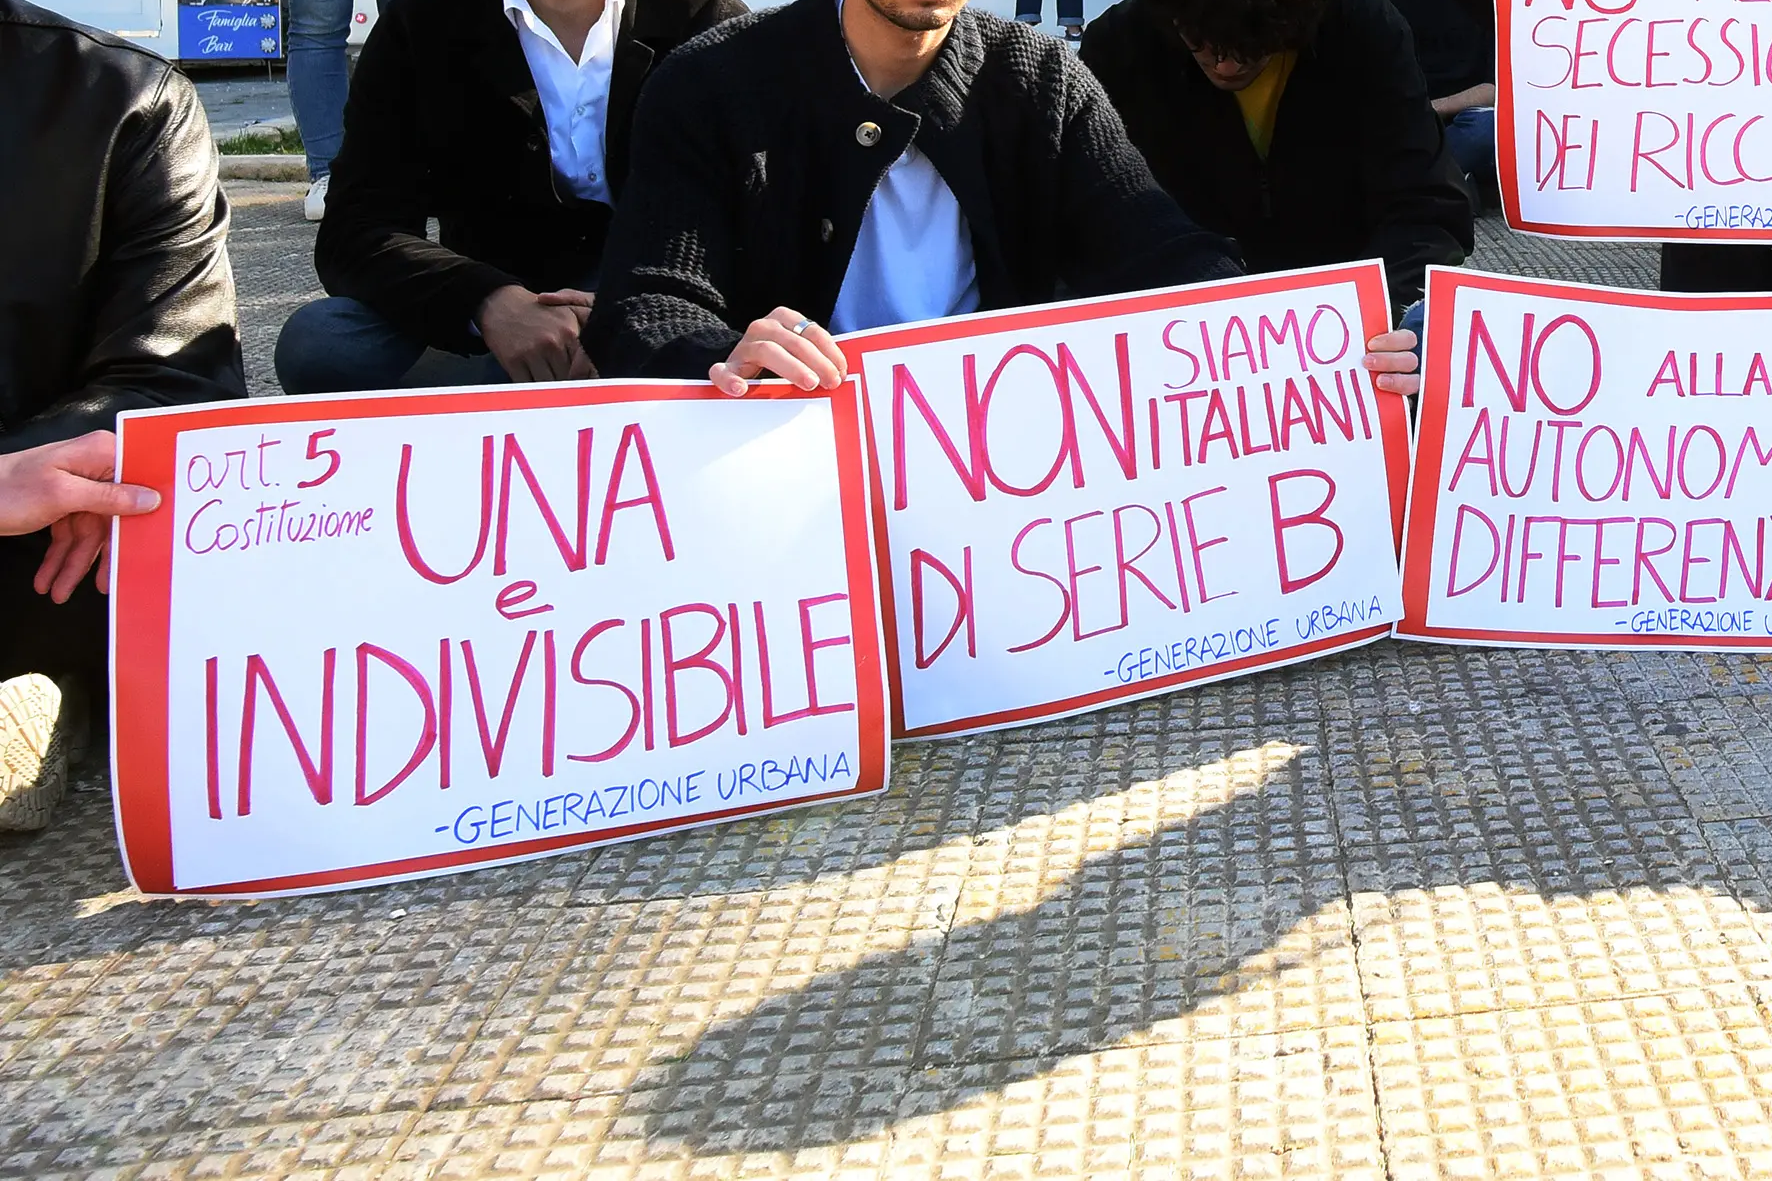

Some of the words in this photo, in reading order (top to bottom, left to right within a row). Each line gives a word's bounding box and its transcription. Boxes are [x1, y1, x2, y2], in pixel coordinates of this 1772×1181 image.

[197, 9, 257, 31] Famiglia
[198, 35, 233, 54] Bari
[1536, 109, 1598, 191] DEI
[892, 332, 1138, 511] NON
[1163, 304, 1350, 389] SIAMO
[1461, 309, 1602, 416] NO
[1646, 350, 1772, 398] ALLA
[187, 434, 282, 493] art.
[297, 428, 342, 490] 5
[1149, 368, 1372, 471] ITALIANI
[397, 423, 675, 586] UNA
[910, 546, 976, 669] DI
[1006, 485, 1239, 653] SERIE
[1268, 469, 1344, 595] B
[1295, 594, 1383, 640] URBANA
[205, 593, 856, 820] INDIVISIBILE
[717, 751, 852, 801] URBANA
